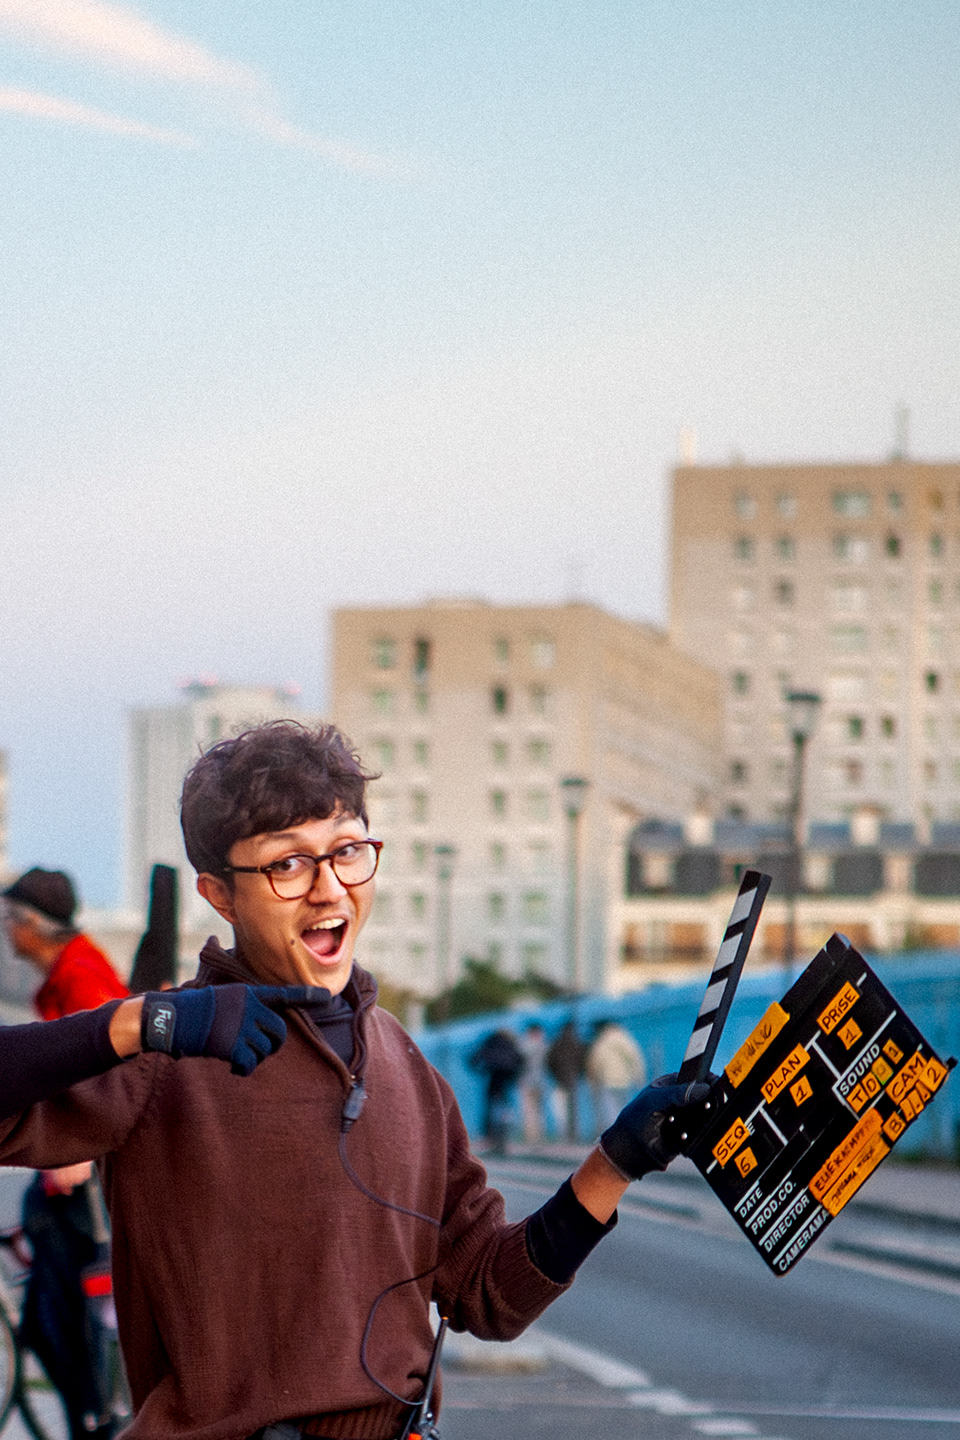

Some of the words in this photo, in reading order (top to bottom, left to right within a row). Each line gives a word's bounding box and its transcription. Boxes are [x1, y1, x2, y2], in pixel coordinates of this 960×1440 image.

[844, 1026, 857, 1044] 1
[765, 1052, 801, 1098] PLAN
[840, 1043, 881, 1096] SOUND
[891, 1056, 925, 1099] CAM
[795, 1084, 809, 1100] 1
[716, 1124, 746, 1161] SEQ
[740, 1158, 752, 1174] 6
[739, 1185, 764, 1219] DATE
[750, 1180, 797, 1236] PROD.CO.
[763, 1192, 811, 1254] DIRECTOR
